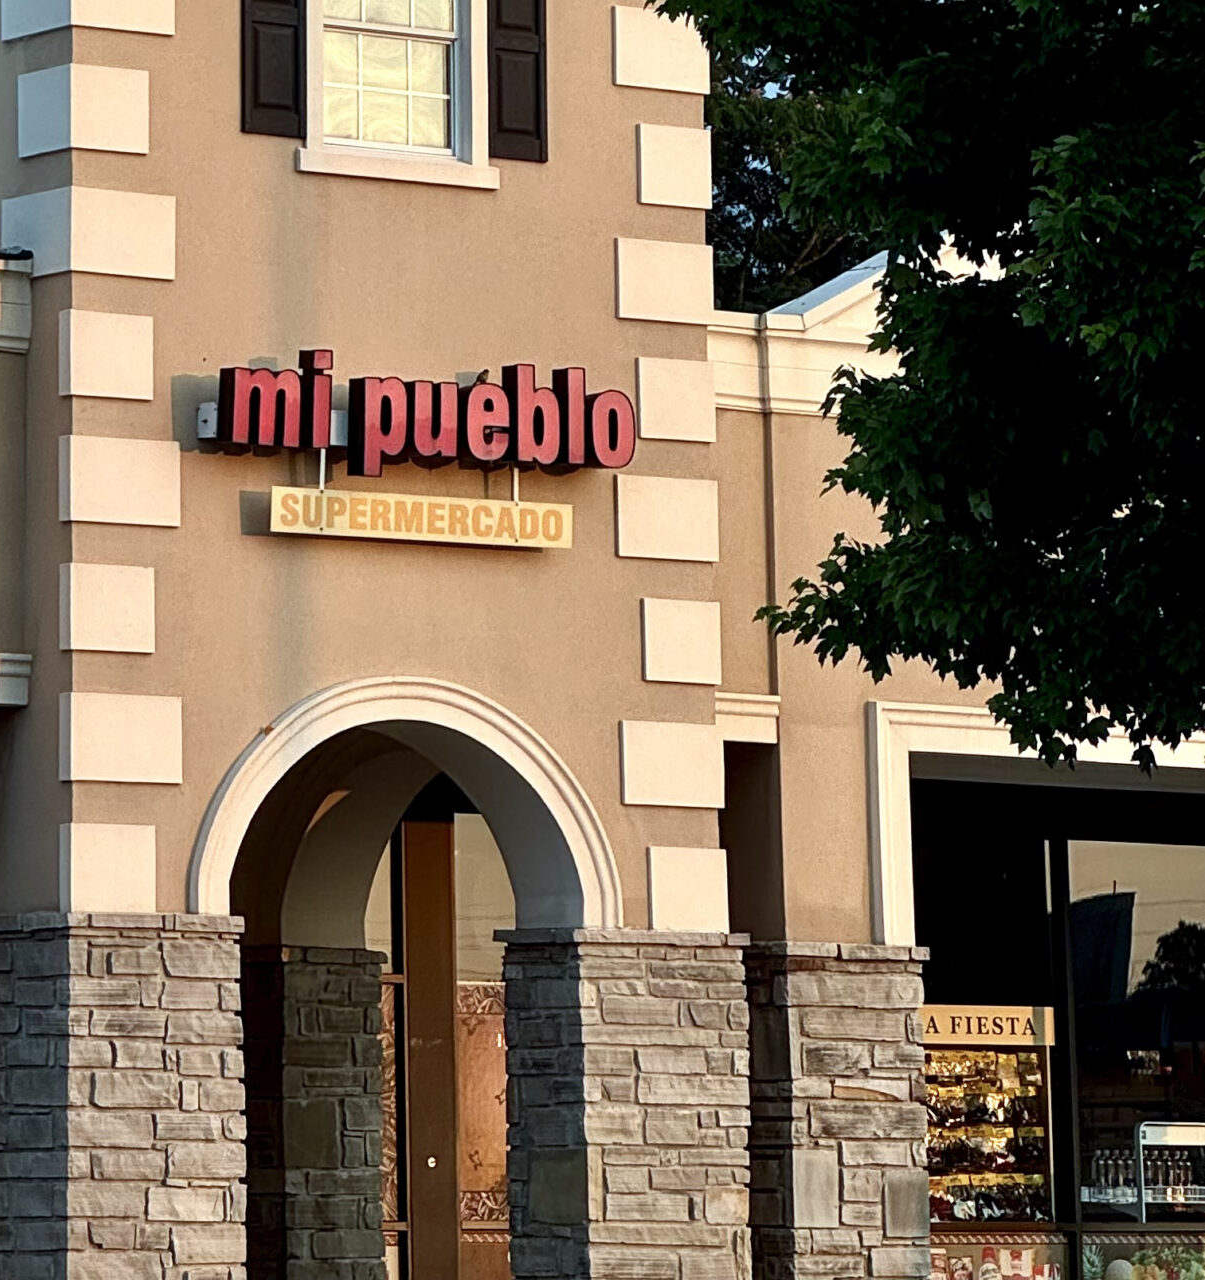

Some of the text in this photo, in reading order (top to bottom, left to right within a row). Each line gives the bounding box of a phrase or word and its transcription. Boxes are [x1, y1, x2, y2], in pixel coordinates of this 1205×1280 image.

[218, 349, 635, 477] mi pueblo
[280, 493, 564, 542] SUPERMERCADO
[950, 1016, 1037, 1036] FIESTA
